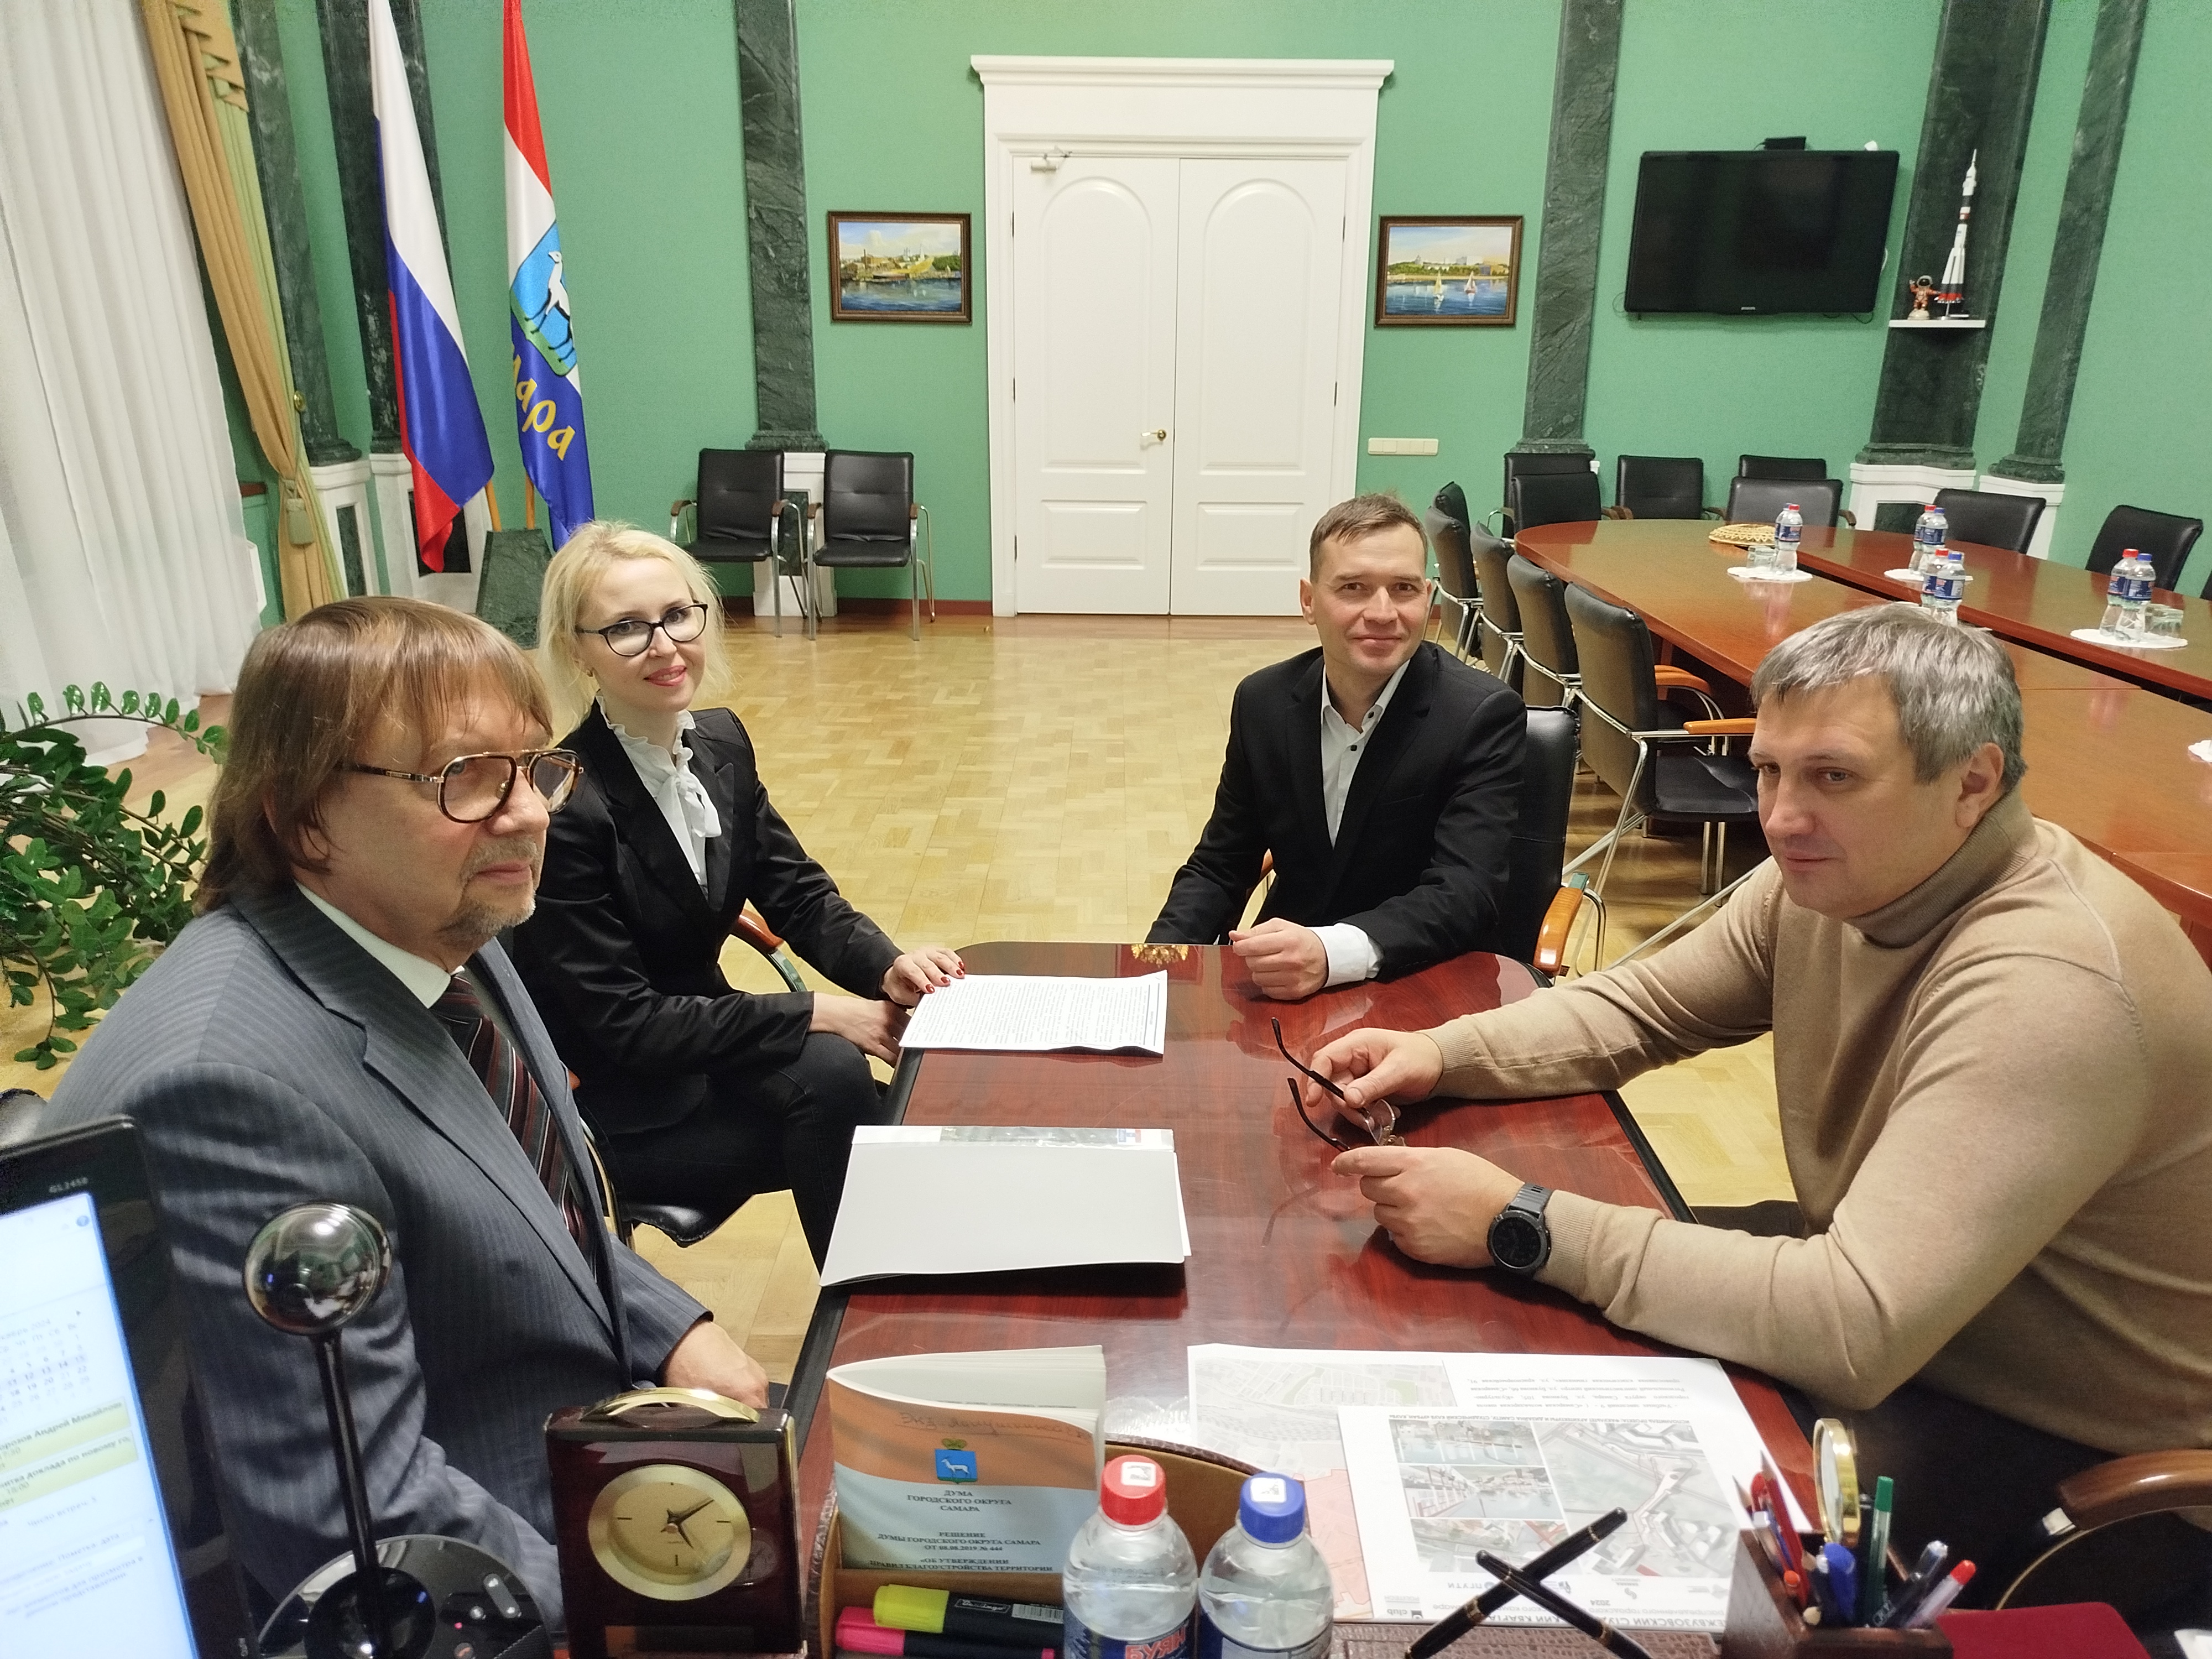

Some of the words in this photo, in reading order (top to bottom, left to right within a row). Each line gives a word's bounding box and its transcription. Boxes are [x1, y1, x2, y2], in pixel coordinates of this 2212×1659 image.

[34, 1420, 70, 1438] Андрей
[27, 1459, 66, 1480] доклада
[81, 1439, 116, 1458] новому
[907, 1495, 972, 1504] ГОРОДСКОГО
[878, 1533, 906, 1542] ДУМЫ
[907, 1536, 967, 1545] ГОРОДСКОГО
[869, 1560, 904, 1569] ПРАВИЛ
[1124, 1624, 1186, 1659] БУЯН
